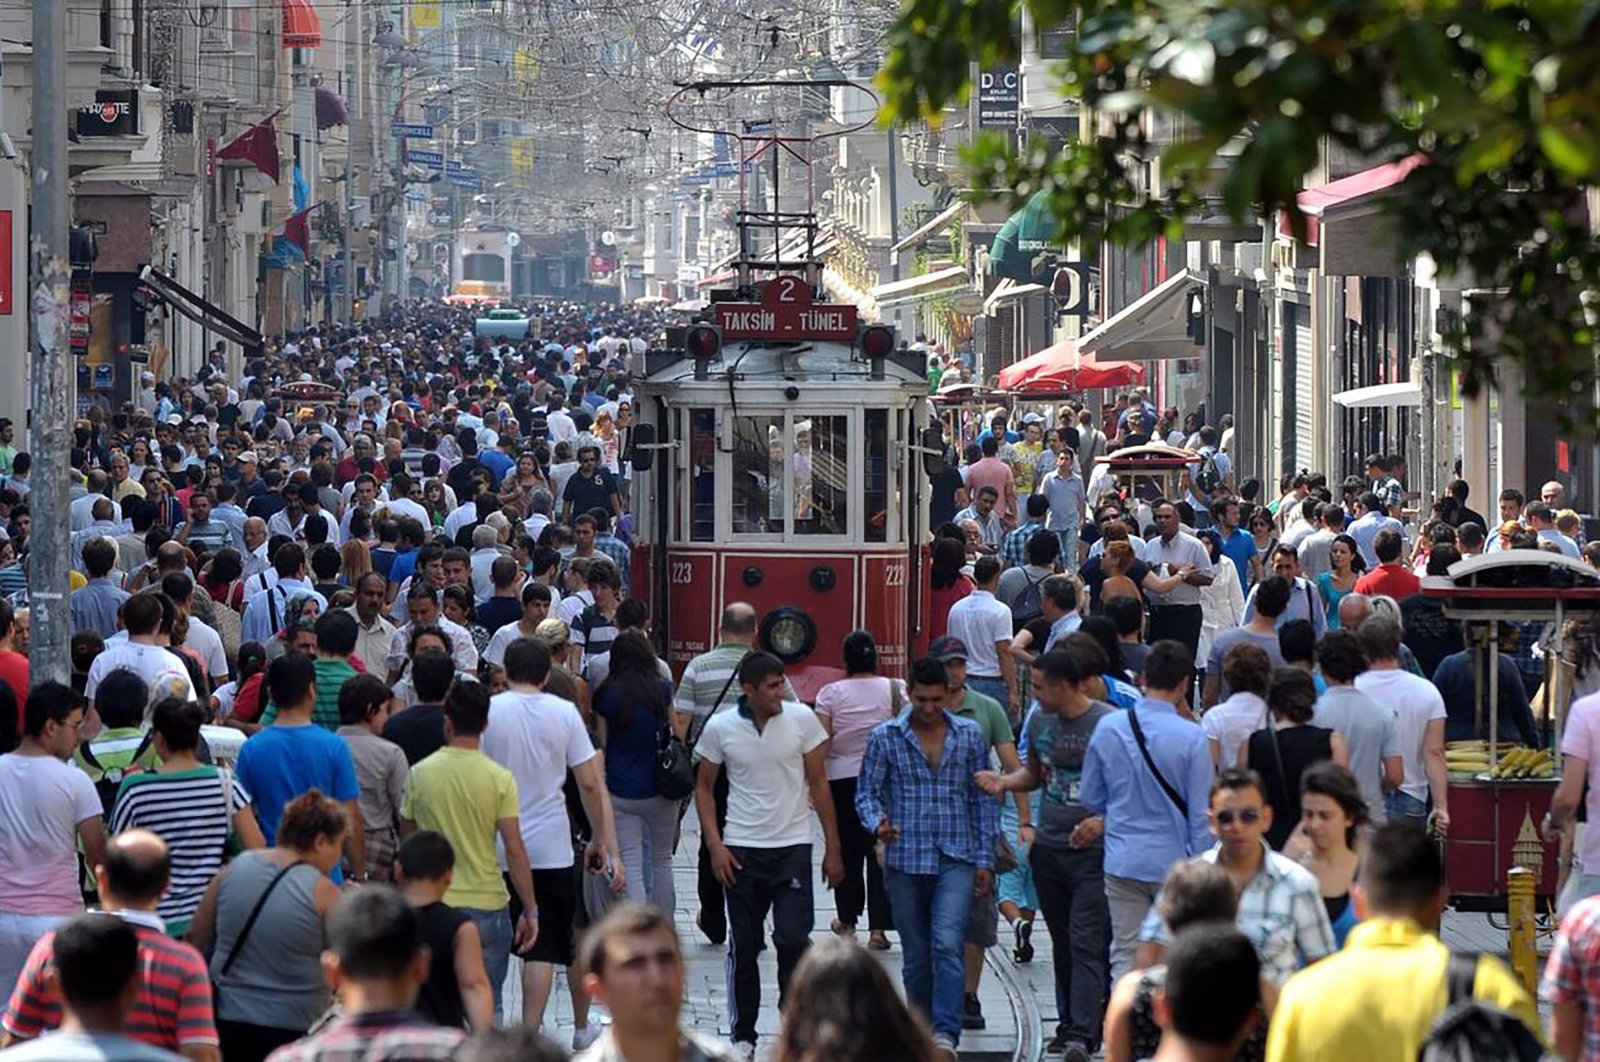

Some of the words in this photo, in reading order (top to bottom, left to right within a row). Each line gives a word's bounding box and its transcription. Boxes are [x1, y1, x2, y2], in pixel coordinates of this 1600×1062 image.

[981, 72, 1017, 89] D&C
[779, 279, 796, 301] 2
[723, 309, 775, 332] TAKSİM
[800, 310, 849, 331] TÜNEL
[672, 562, 692, 584] 223
[885, 564, 905, 587] 223
